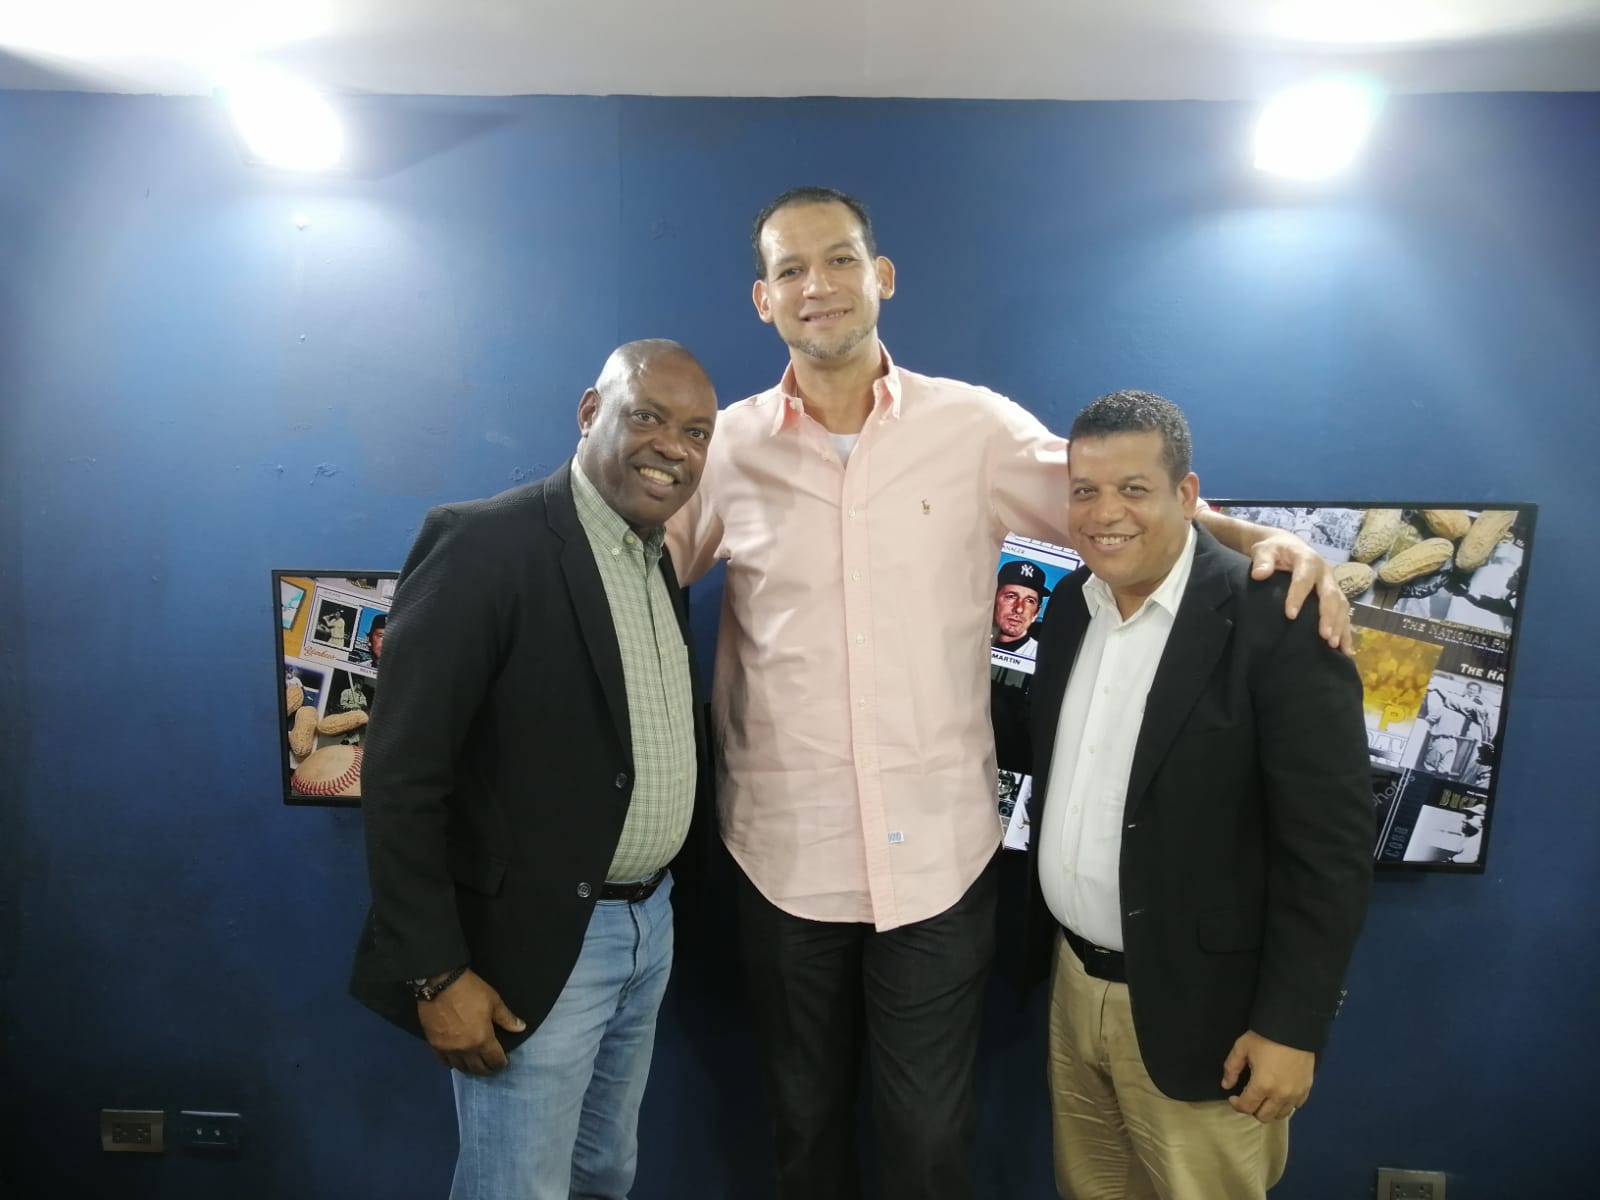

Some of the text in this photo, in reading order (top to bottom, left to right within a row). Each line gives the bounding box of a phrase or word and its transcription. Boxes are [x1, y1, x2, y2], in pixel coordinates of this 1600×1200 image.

[1402, 617, 1426, 633] THE
[1428, 623, 1488, 647] NATIONAL
[991, 653, 1021, 665] MARTIN
[1460, 663, 1484, 677] THE
[1486, 669, 1504, 682] HA
